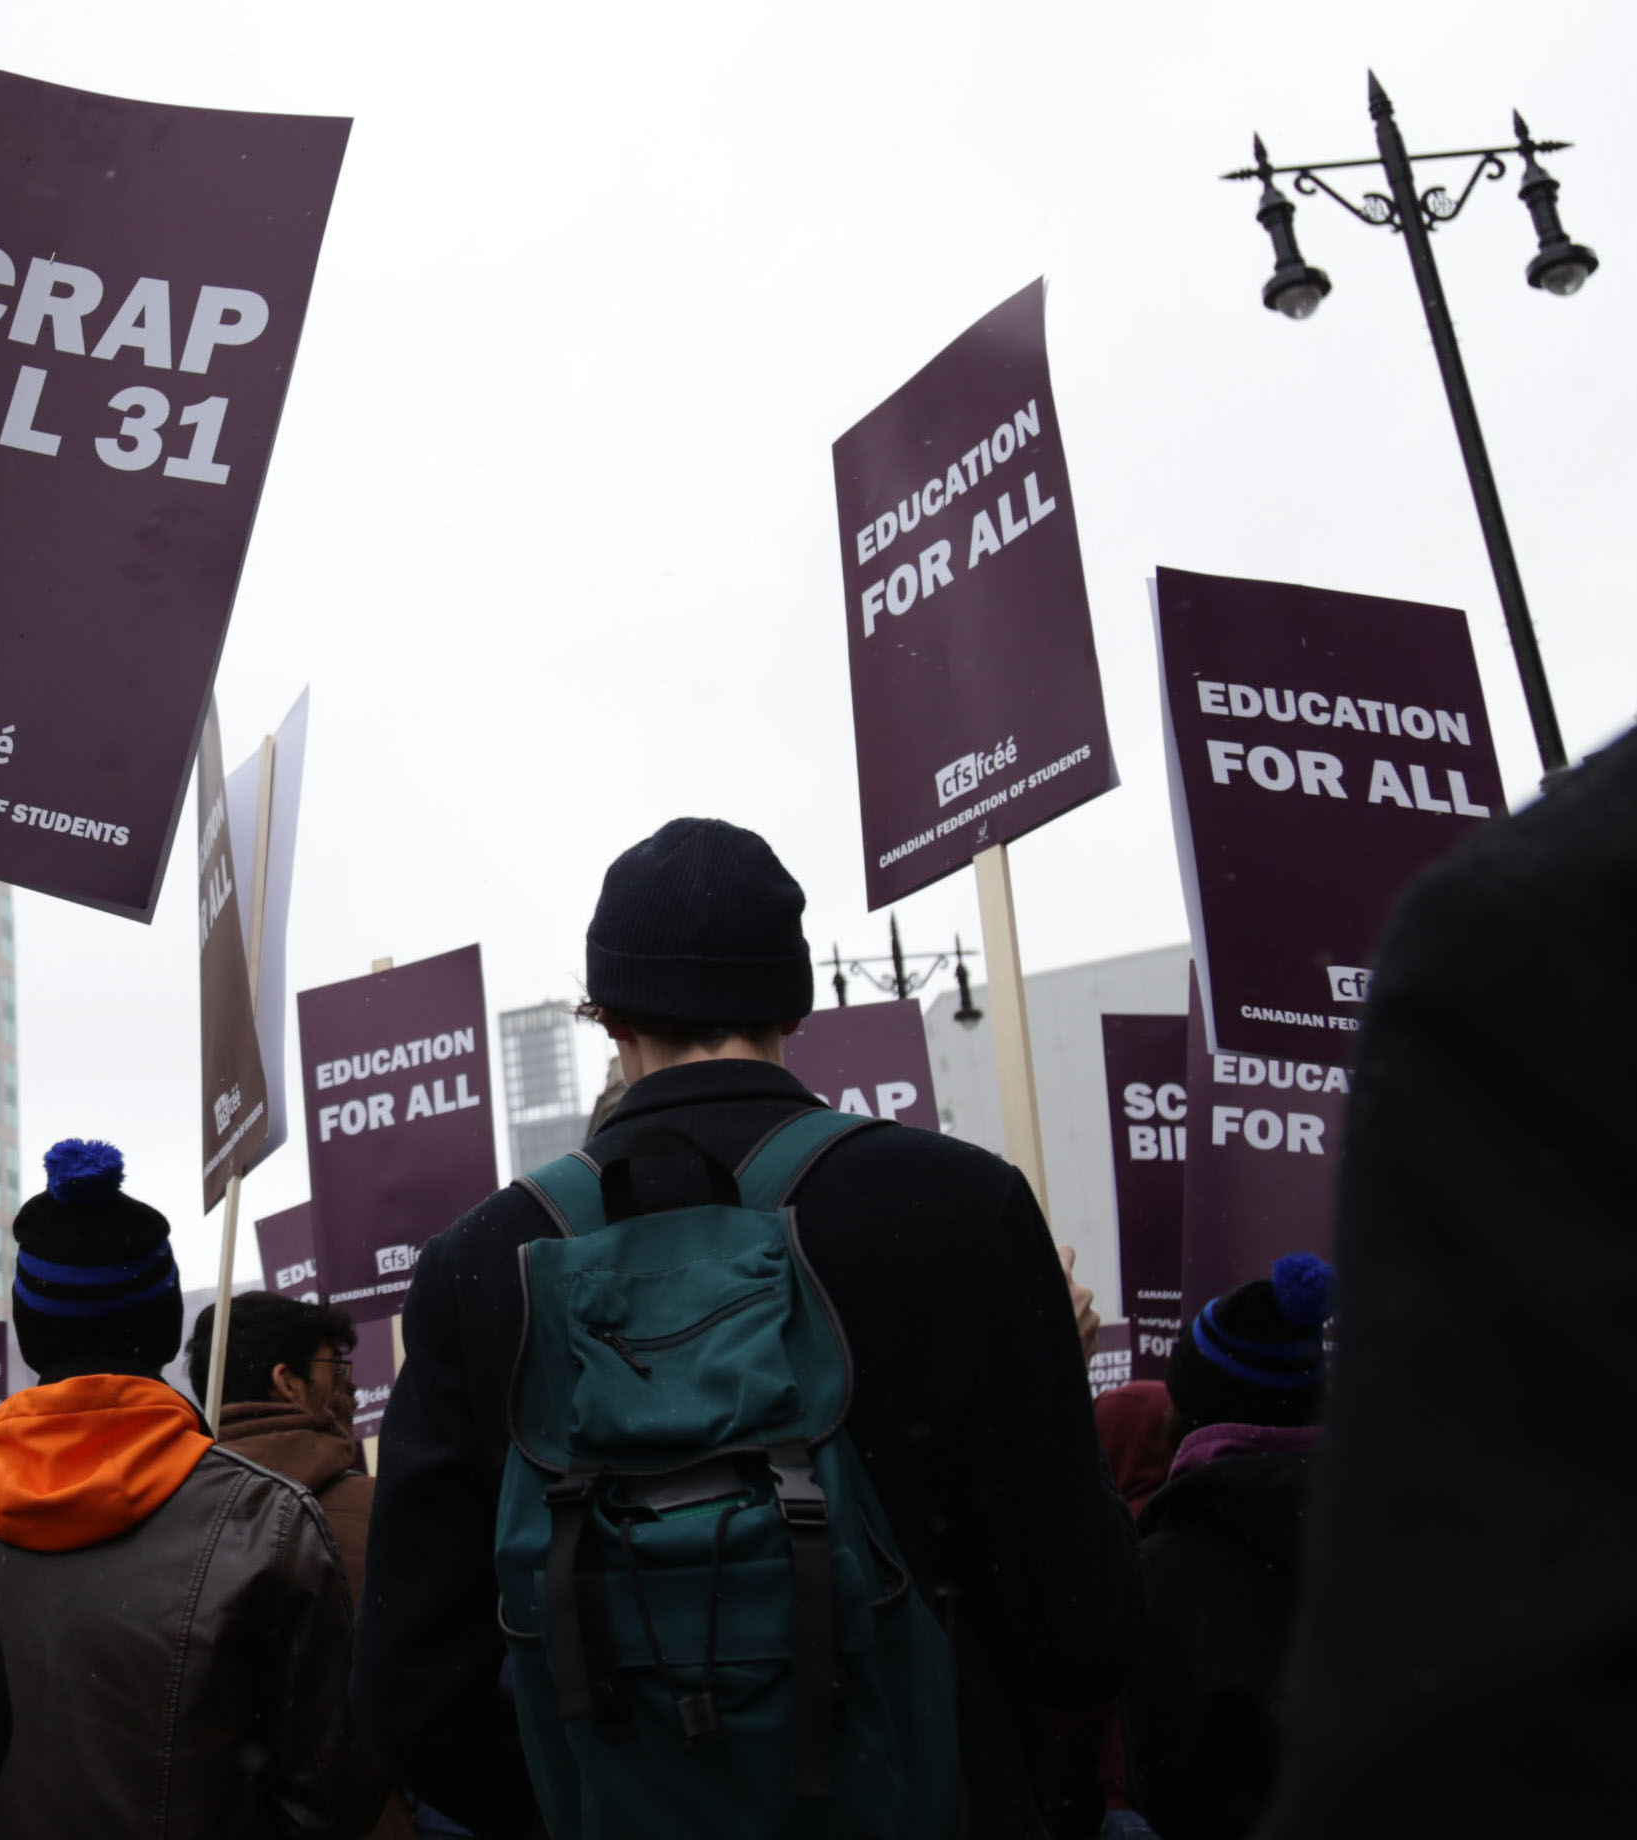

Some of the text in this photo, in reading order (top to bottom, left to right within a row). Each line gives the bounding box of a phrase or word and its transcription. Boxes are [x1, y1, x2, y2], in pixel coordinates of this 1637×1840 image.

[94, 386, 231, 485] 31
[856, 398, 1041, 566] EDUCATION
[861, 471, 1056, 638] FOR ALL
[1197, 680, 1472, 745] EDUCATION
[879, 744, 1091, 868] CANADIAN FEDERATION OF STUDENTS
[1207, 739, 1490, 818] FOR ALL
[11, 804, 130, 847] STUDENTS
[1241, 1005, 1324, 1028] CANADIAN
[316, 1027, 475, 1090] EDUCATION
[1214, 1055, 1354, 1094] EDUCA
[319, 1074, 480, 1143] FOR ALL
[1212, 1106, 1324, 1154] FOR
[329, 1287, 375, 1303] CANADIAN
